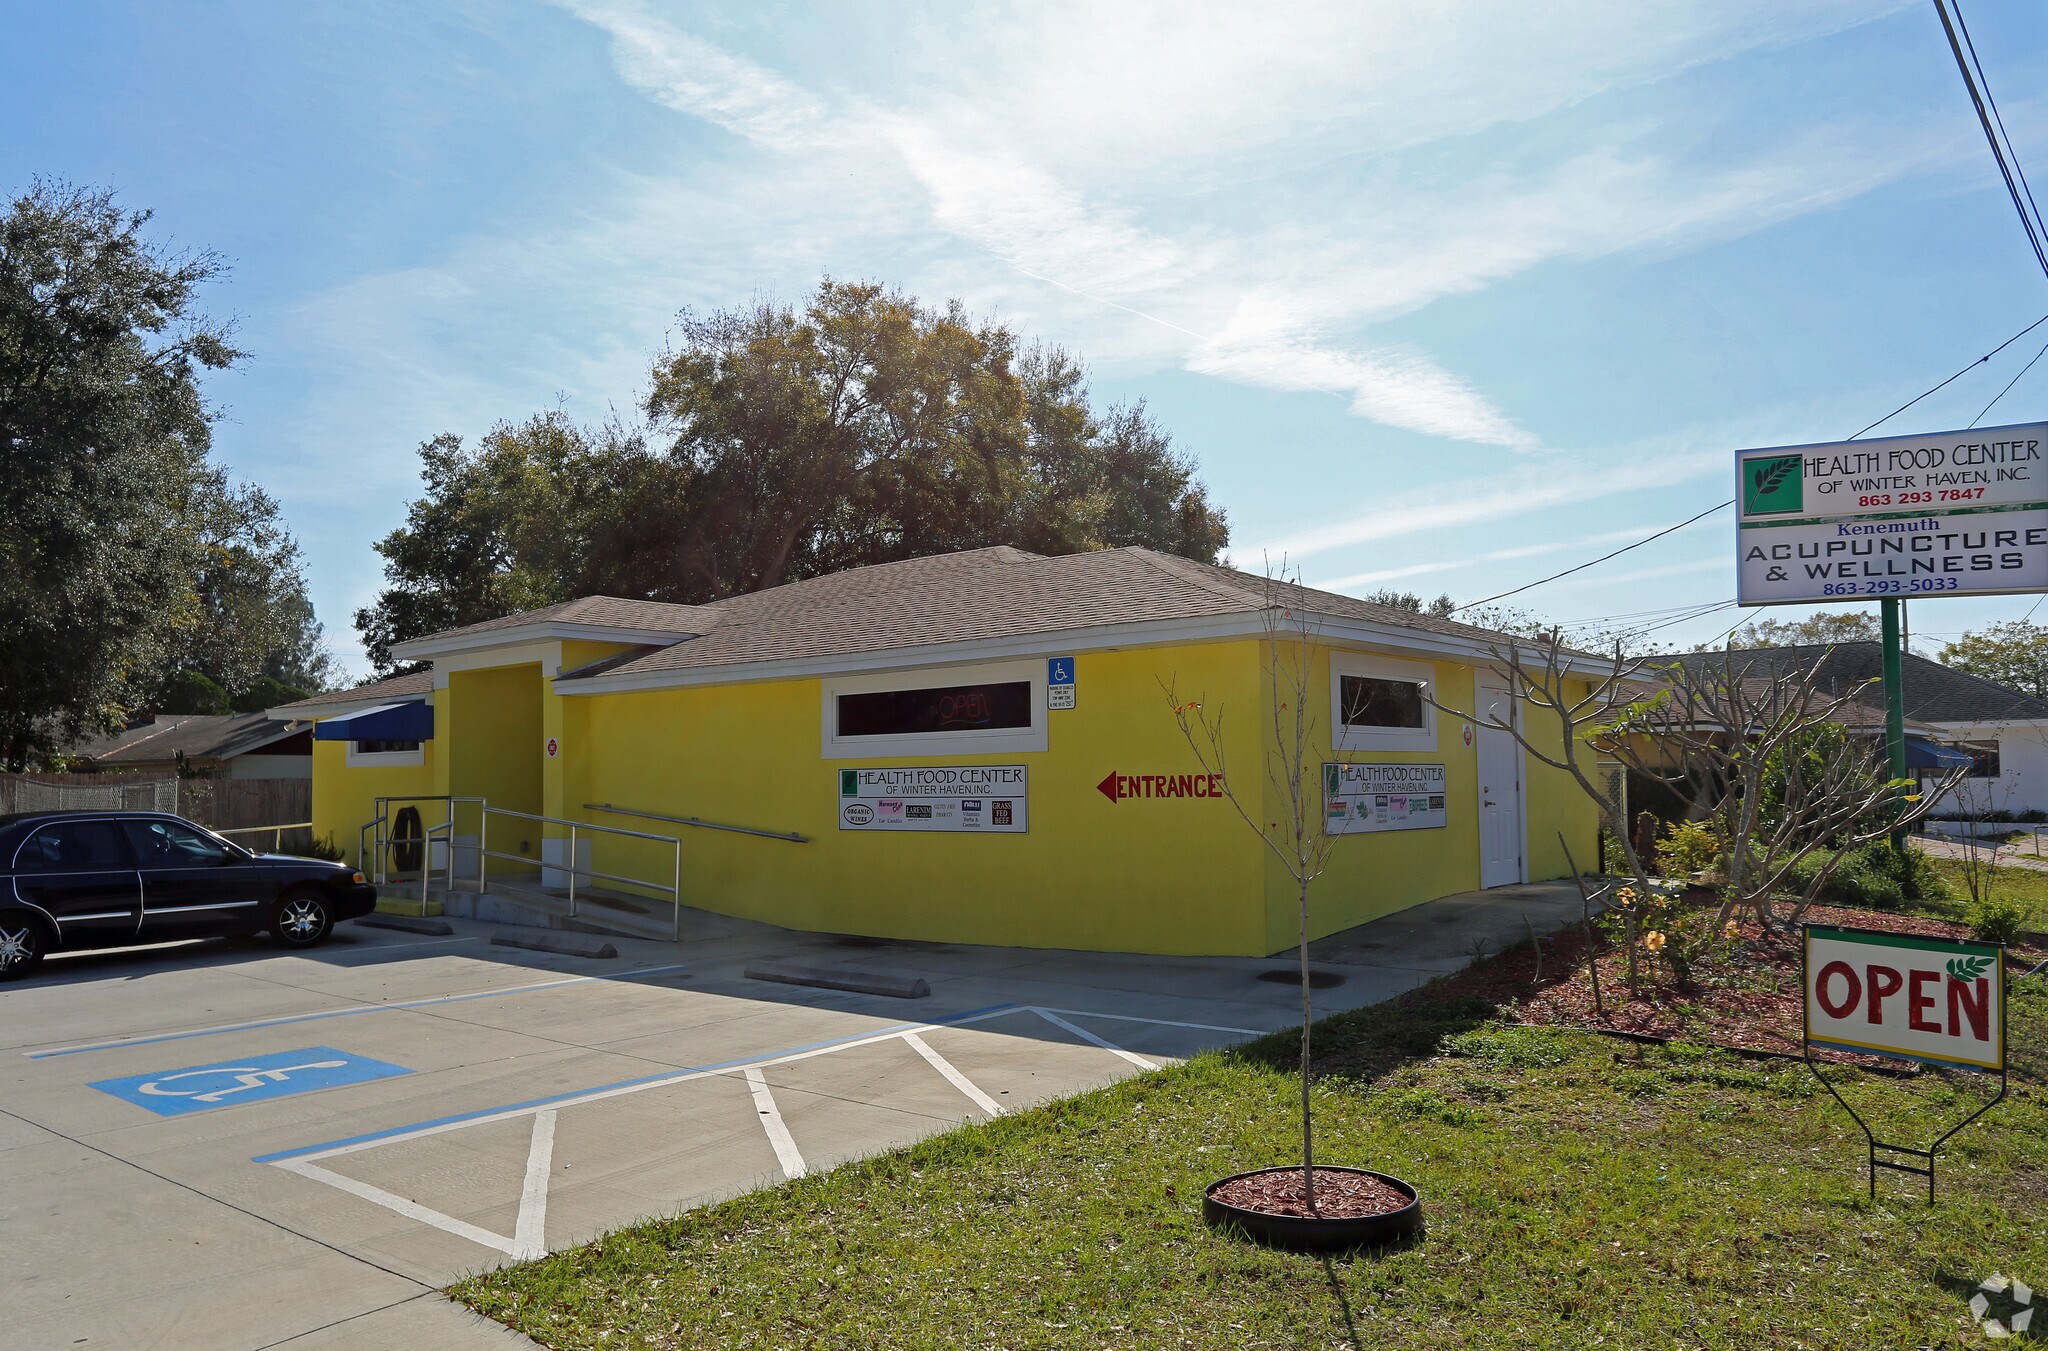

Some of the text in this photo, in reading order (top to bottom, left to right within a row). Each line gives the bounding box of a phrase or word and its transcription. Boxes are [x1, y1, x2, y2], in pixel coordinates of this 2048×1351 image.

[1804, 440, 2040, 478] HEALTH FOOD CENTER
[1817, 466, 2031, 494] OF WINTER HAVEN, INC.
[1858, 487, 1985, 507] 863 293 7847
[1837, 518, 1941, 536] Kenemuth
[1745, 528, 2048, 562] ACUPUNCTURE
[1765, 552, 2023, 581] & WELLNESS
[1823, 577, 1959, 596] 863-293-5033
[940, 693, 991, 719] OPEN
[858, 769, 1023, 785] HEALTH FOOD CENTER
[1341, 767, 1444, 781] HEALTH FOOD CENTER
[886, 785, 898, 795] OF
[901, 785, 937, 795] WINTER
[1117, 774, 1223, 798] ENTRANCE
[1362, 783, 1370, 792] OF
[1372, 782, 1396, 792] WINTER
[992, 802, 1012, 810] GRASS
[1815, 960, 1990, 1042] OPEN
